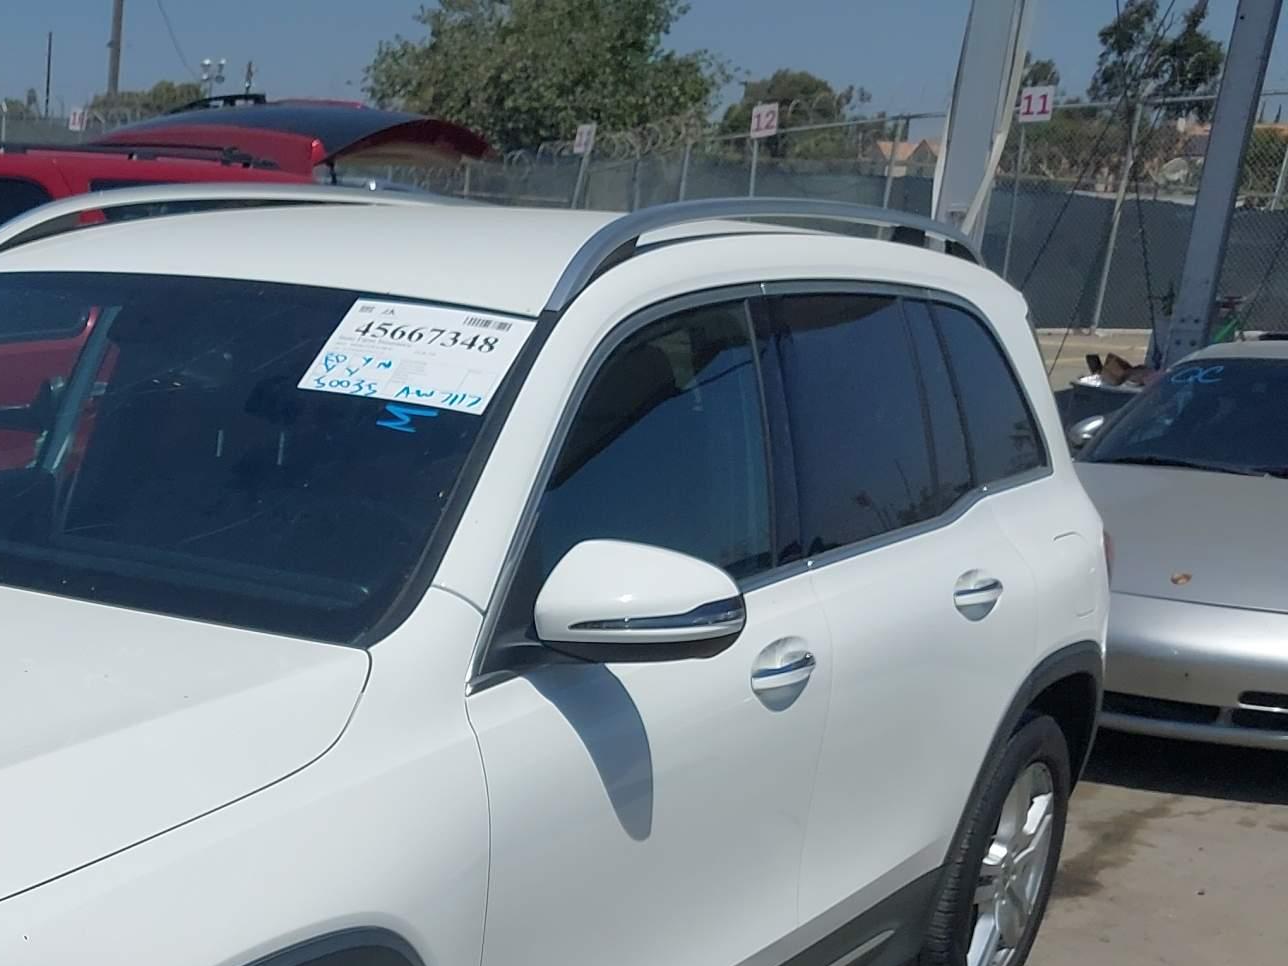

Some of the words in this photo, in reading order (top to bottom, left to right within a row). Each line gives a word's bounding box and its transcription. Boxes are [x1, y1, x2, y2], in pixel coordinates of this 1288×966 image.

[1023, 94, 1049, 115] 11
[754, 110, 777, 132] 12
[354, 319, 500, 354] 45667348
